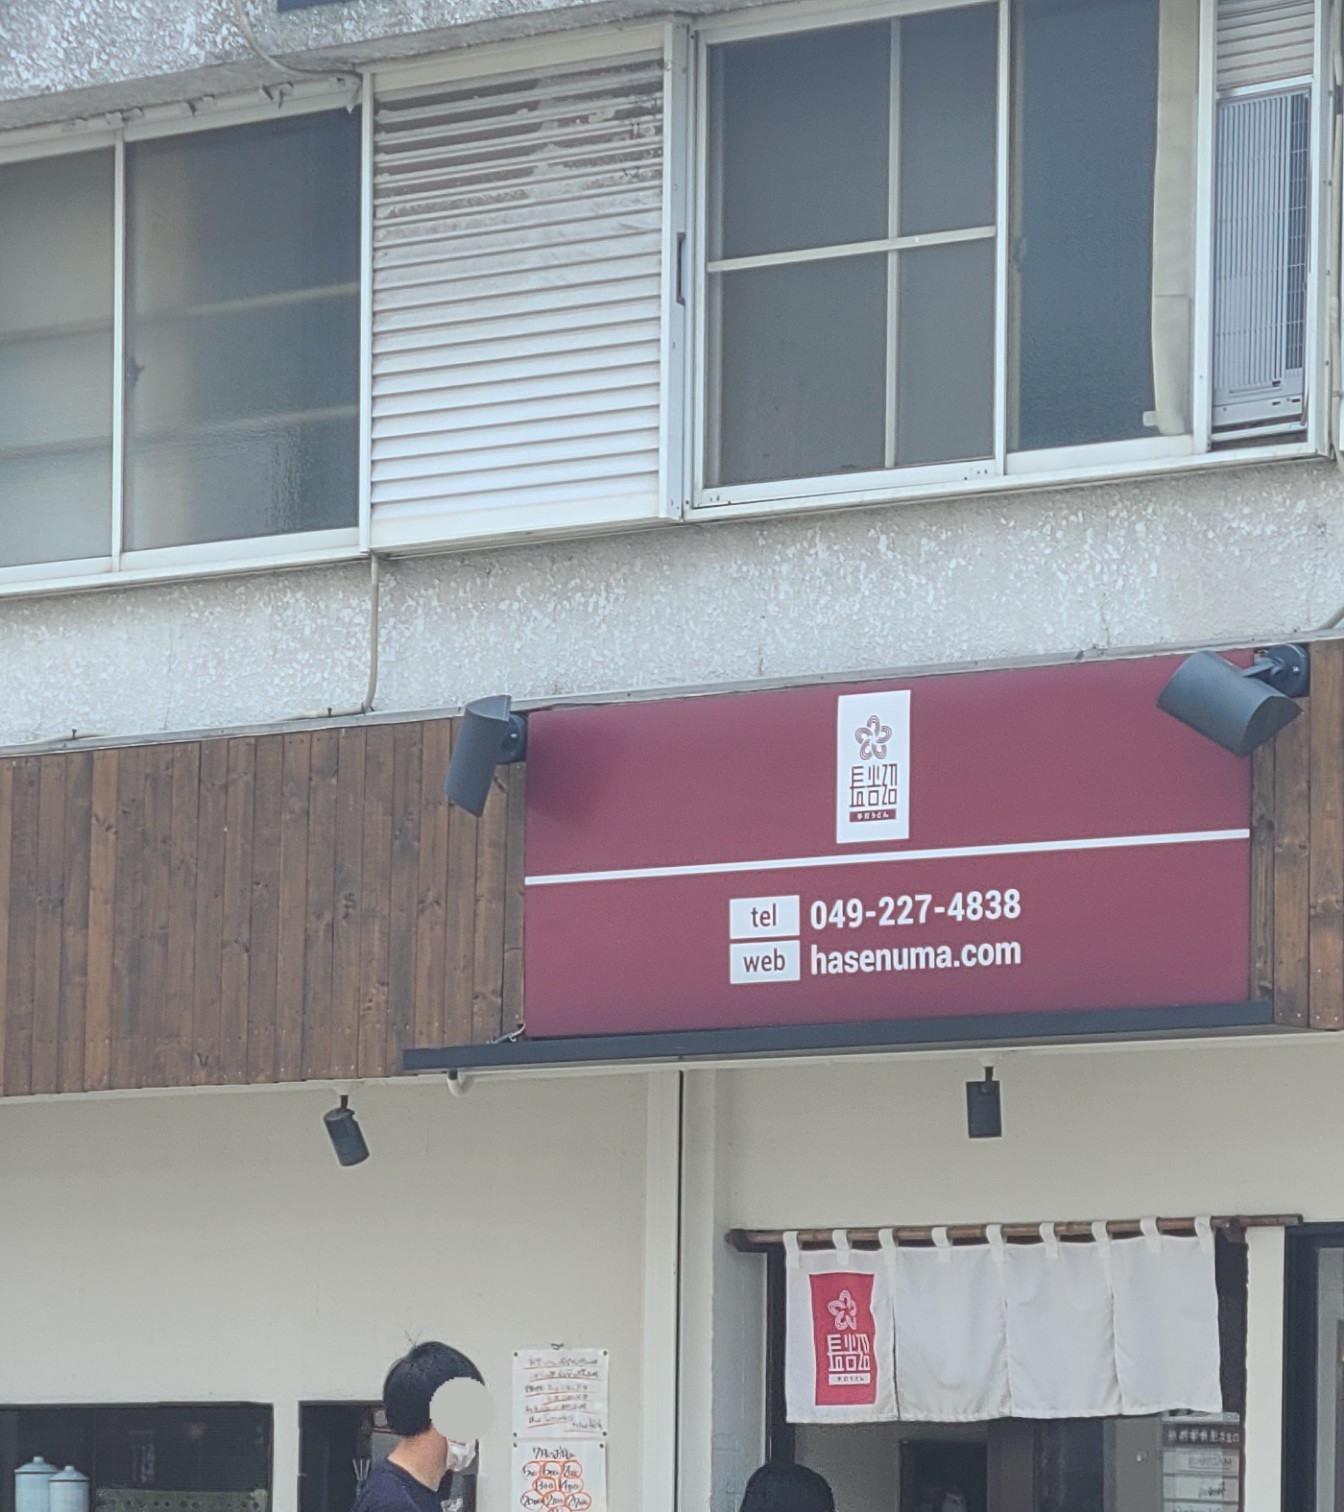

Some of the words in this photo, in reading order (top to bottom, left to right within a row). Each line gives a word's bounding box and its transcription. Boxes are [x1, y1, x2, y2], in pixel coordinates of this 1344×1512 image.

[750, 905, 778, 929] tel
[809, 889, 1021, 931] 049-227-4838
[743, 949, 786, 974] web
[809, 939, 1021, 976] hasenuma.com
